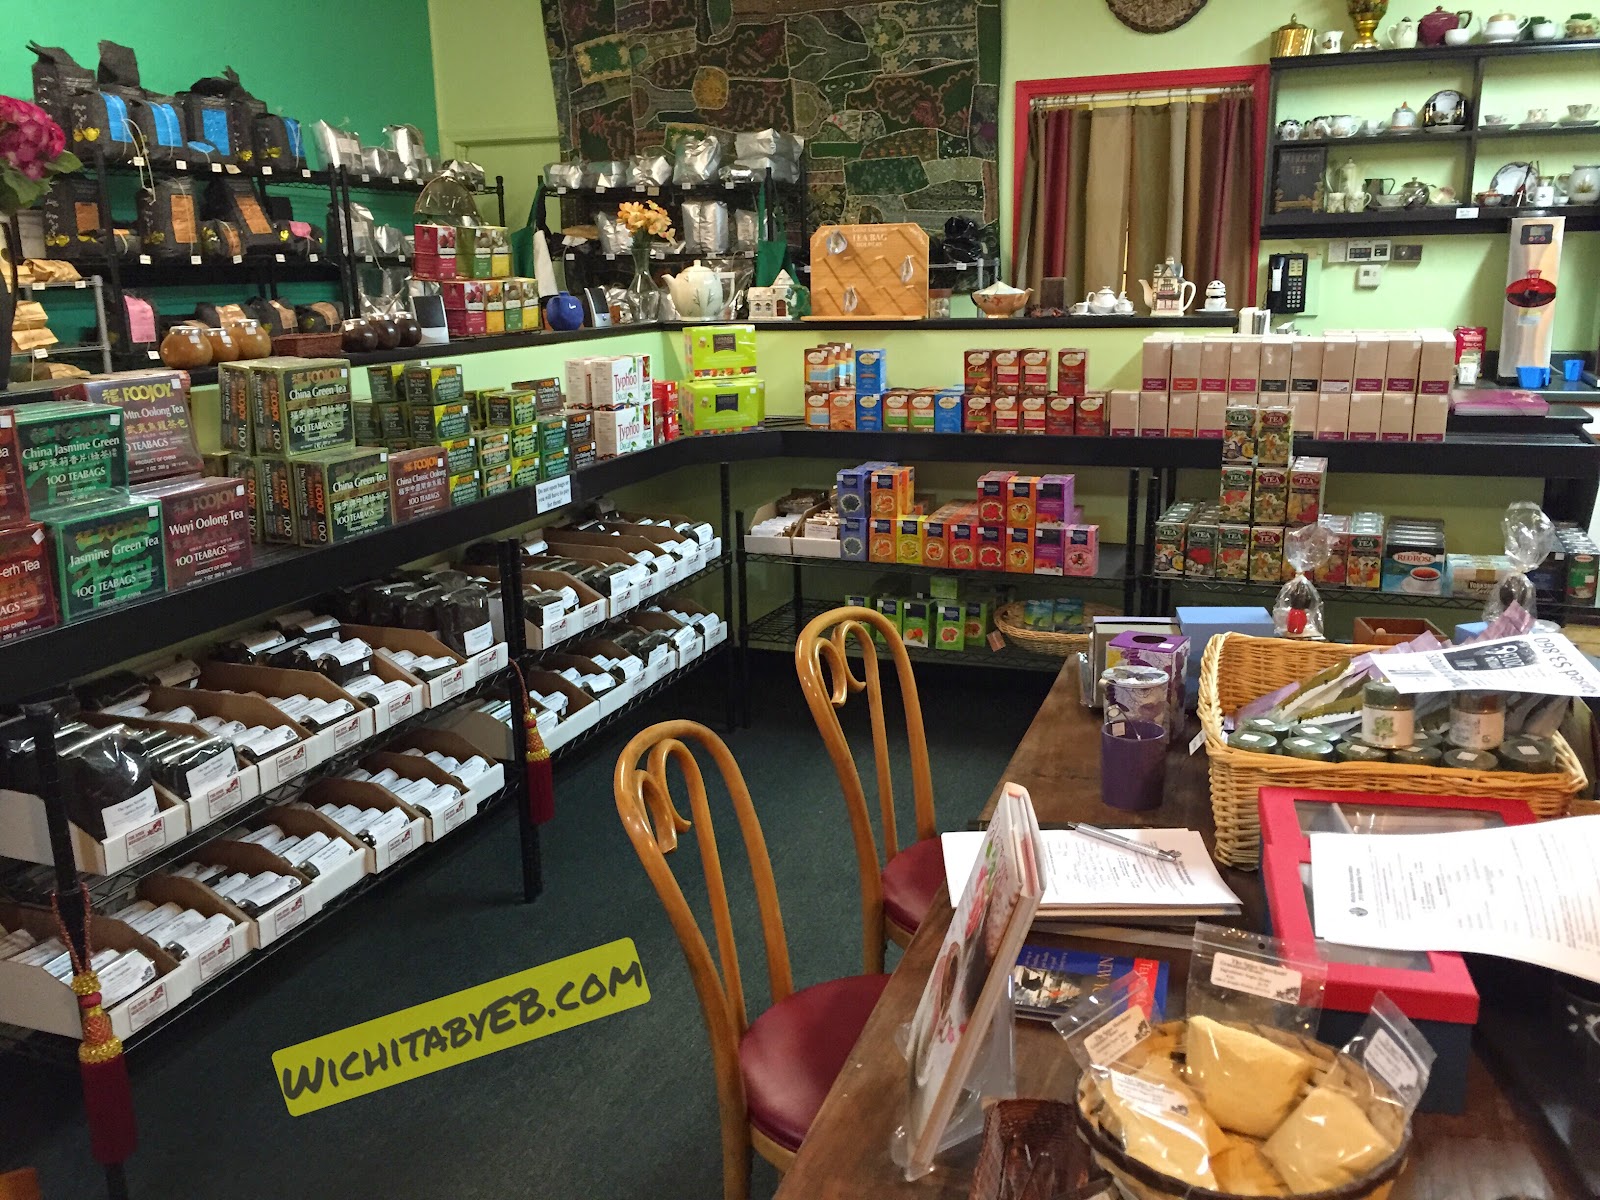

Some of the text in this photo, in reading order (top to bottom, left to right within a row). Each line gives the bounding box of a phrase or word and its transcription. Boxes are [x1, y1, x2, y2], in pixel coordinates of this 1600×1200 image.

[123, 383, 172, 402] FOOJOY
[289, 384, 347, 400] China Green Tea
[614, 373, 637, 392] Typhoo
[141, 407, 172, 417] Oolong
[170, 405, 184, 414] Tea
[238, 427, 246, 447] 100
[293, 421, 334, 434] 100 TEABAGS
[618, 422, 639, 442] Typhoo
[22, 444, 53, 459] China
[54, 441, 91, 456] Jasmine
[92, 437, 120, 447] Green
[132, 438, 169, 451] TEABAGS
[273, 429, 281, 449] 100
[46, 466, 106, 486] 100 TEABAGS
[333, 472, 387, 493] China Green Tea
[396, 476, 412, 487] China
[412, 472, 429, 483] Classic
[408, 497, 419, 505] 100
[168, 510, 244, 536] Wuyi Oolong Tea
[282, 514, 292, 537] 100
[336, 508, 375, 526] 100 TEABAGS
[317, 521, 327, 542] 100
[70, 549, 109, 568] Jasmine
[112, 540, 141, 555] Green
[143, 536, 159, 548] Tea
[175, 545, 227, 567] 100 TEABAGS
[1413, 554, 1432, 562] ROSE
[21, 559, 41, 571] Tea
[195, 567, 214, 576] PRODUCT
[76, 573, 137, 598] 100 TEABAGS
[1534, 638, 1573, 668] $3,860
[1097, 957, 1114, 978] NEW
